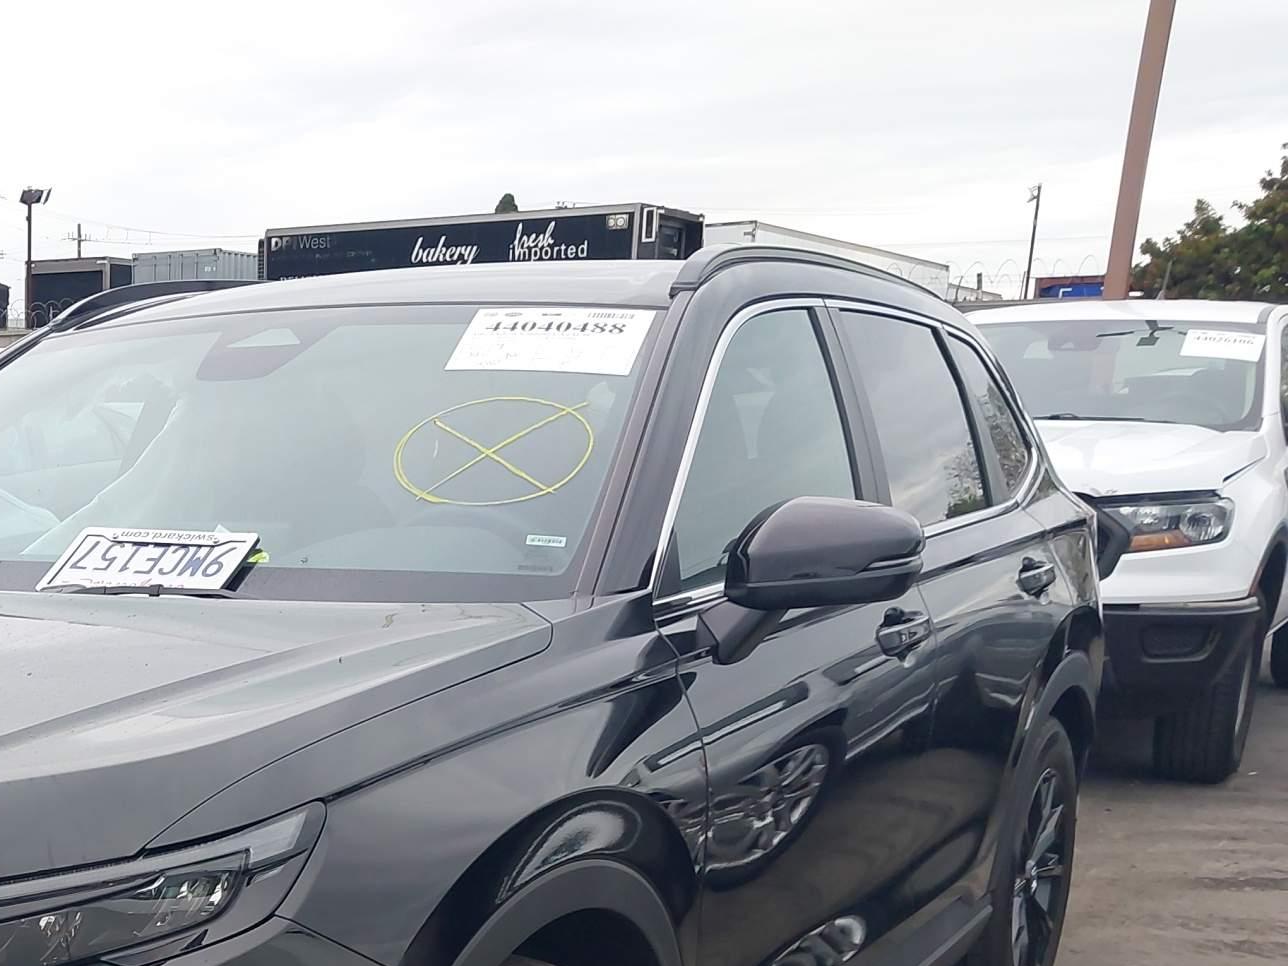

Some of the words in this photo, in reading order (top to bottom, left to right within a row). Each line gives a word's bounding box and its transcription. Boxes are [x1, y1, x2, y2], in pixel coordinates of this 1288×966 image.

[298, 235, 332, 249] West
[514, 221, 556, 256] fresh
[411, 236, 480, 265] bakery
[509, 240, 588, 262] imported
[485, 320, 627, 335] 44040488
[120, 531, 216, 542] swickard.com
[69, 540, 238, 578] 9MCE157
